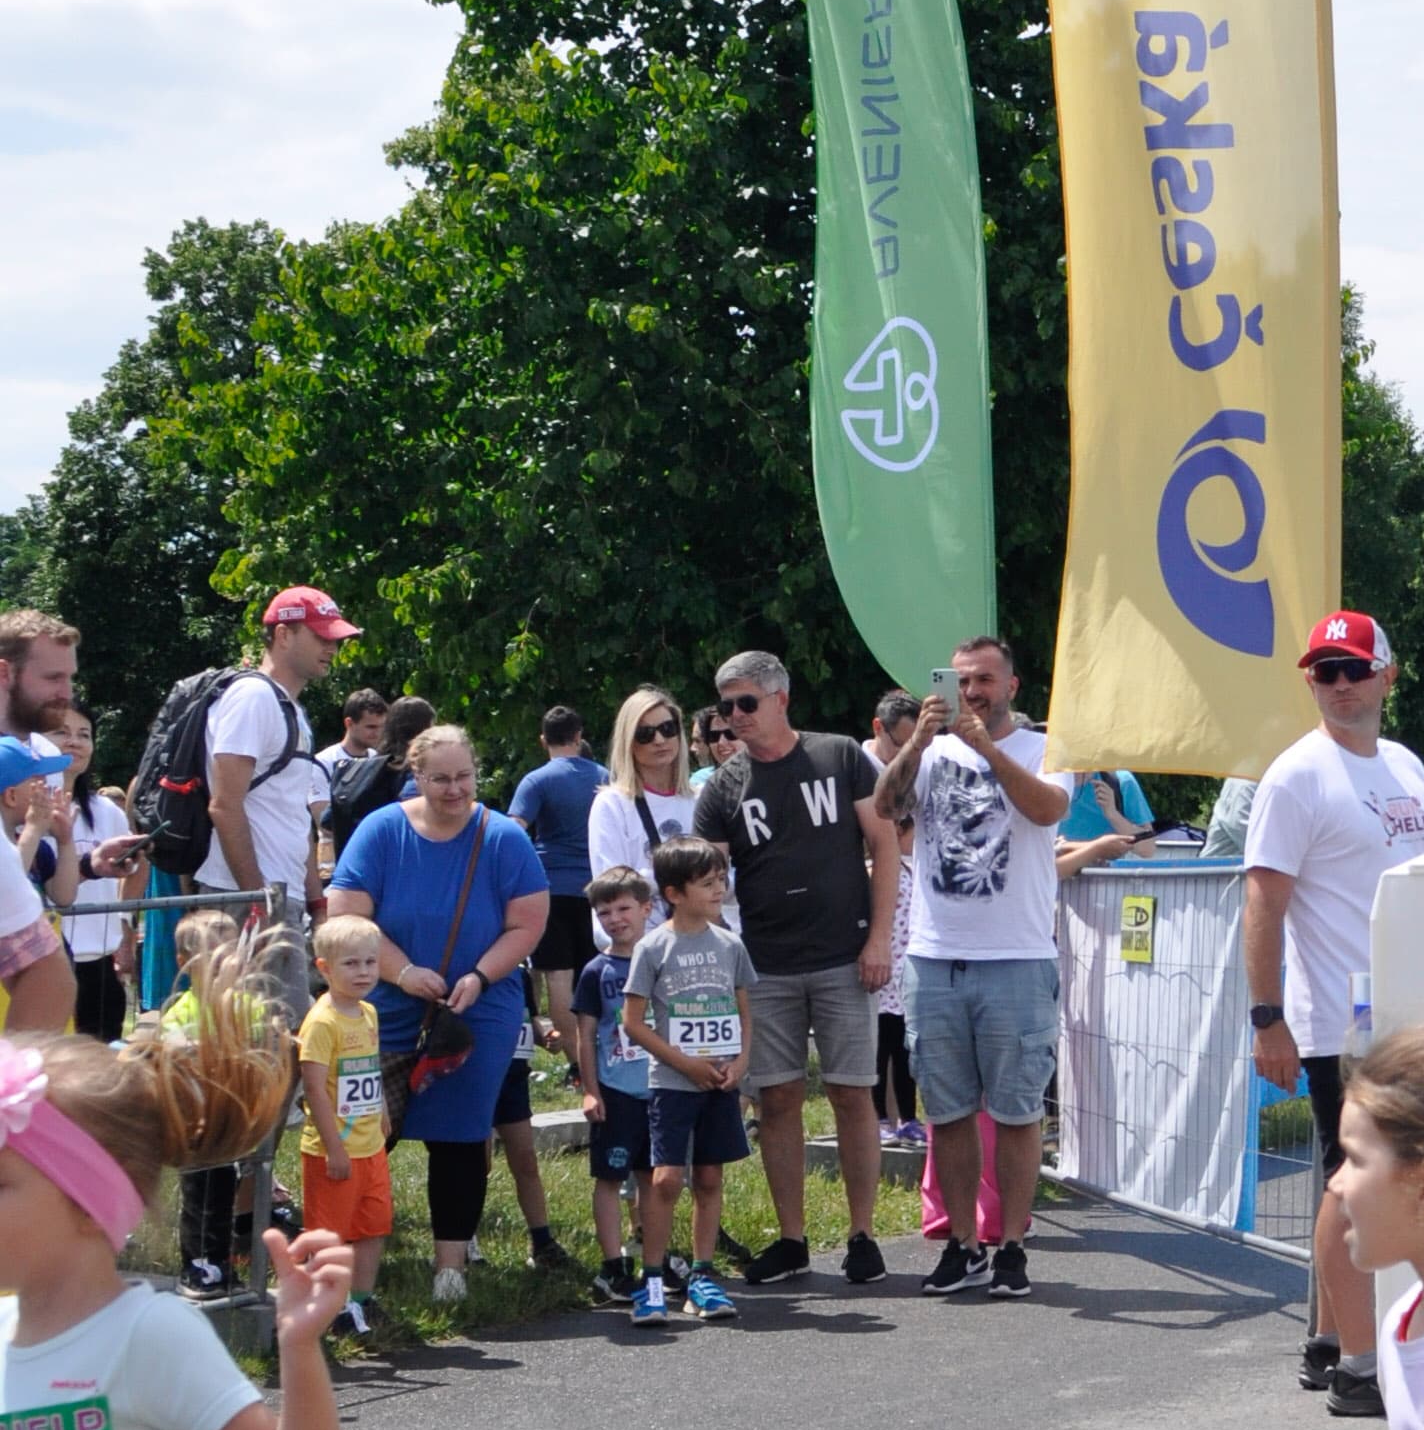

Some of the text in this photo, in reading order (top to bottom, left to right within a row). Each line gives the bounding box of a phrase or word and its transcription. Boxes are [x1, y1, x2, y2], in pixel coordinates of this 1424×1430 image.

[741, 776, 838, 846] R W
[676, 951, 718, 968] WHO IS
[679, 1019, 733, 1043] 2136
